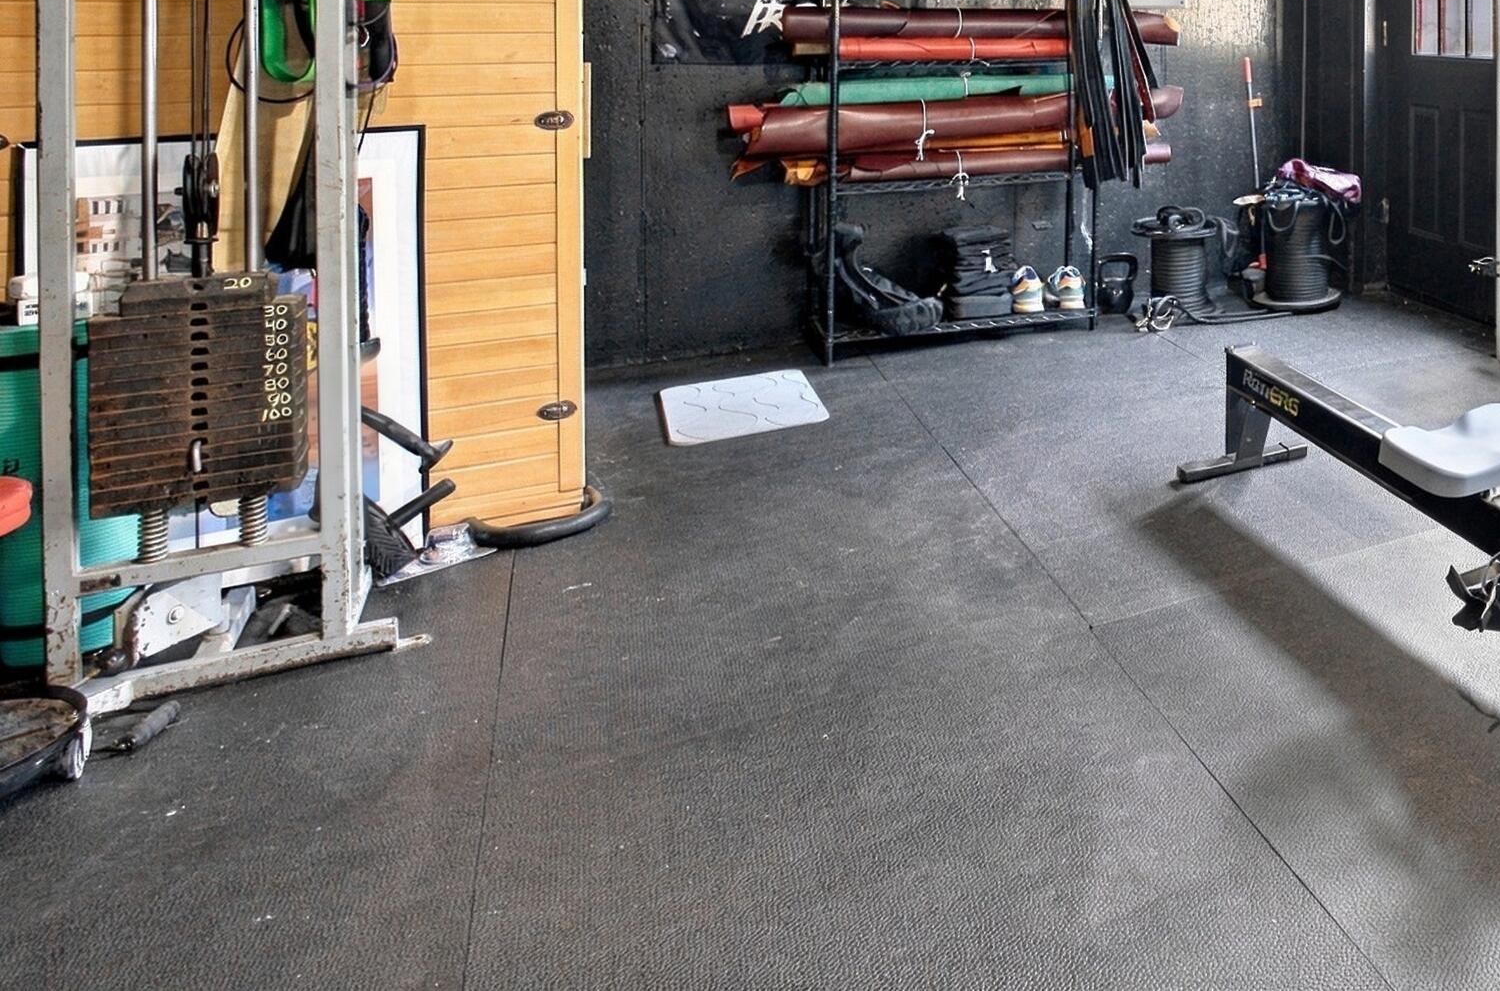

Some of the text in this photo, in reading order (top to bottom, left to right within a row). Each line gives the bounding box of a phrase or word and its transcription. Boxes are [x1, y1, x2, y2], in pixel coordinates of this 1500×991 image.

[224, 277, 251, 289] 20
[264, 305, 287, 317] 30
[265, 319, 287, 331] 40
[265, 334, 288, 347] 50
[265, 348, 287, 361] 60
[262, 362, 287, 376] 70
[265, 377, 289, 391] 80
[267, 392, 291, 407] 90
[262, 407, 292, 422] 100
